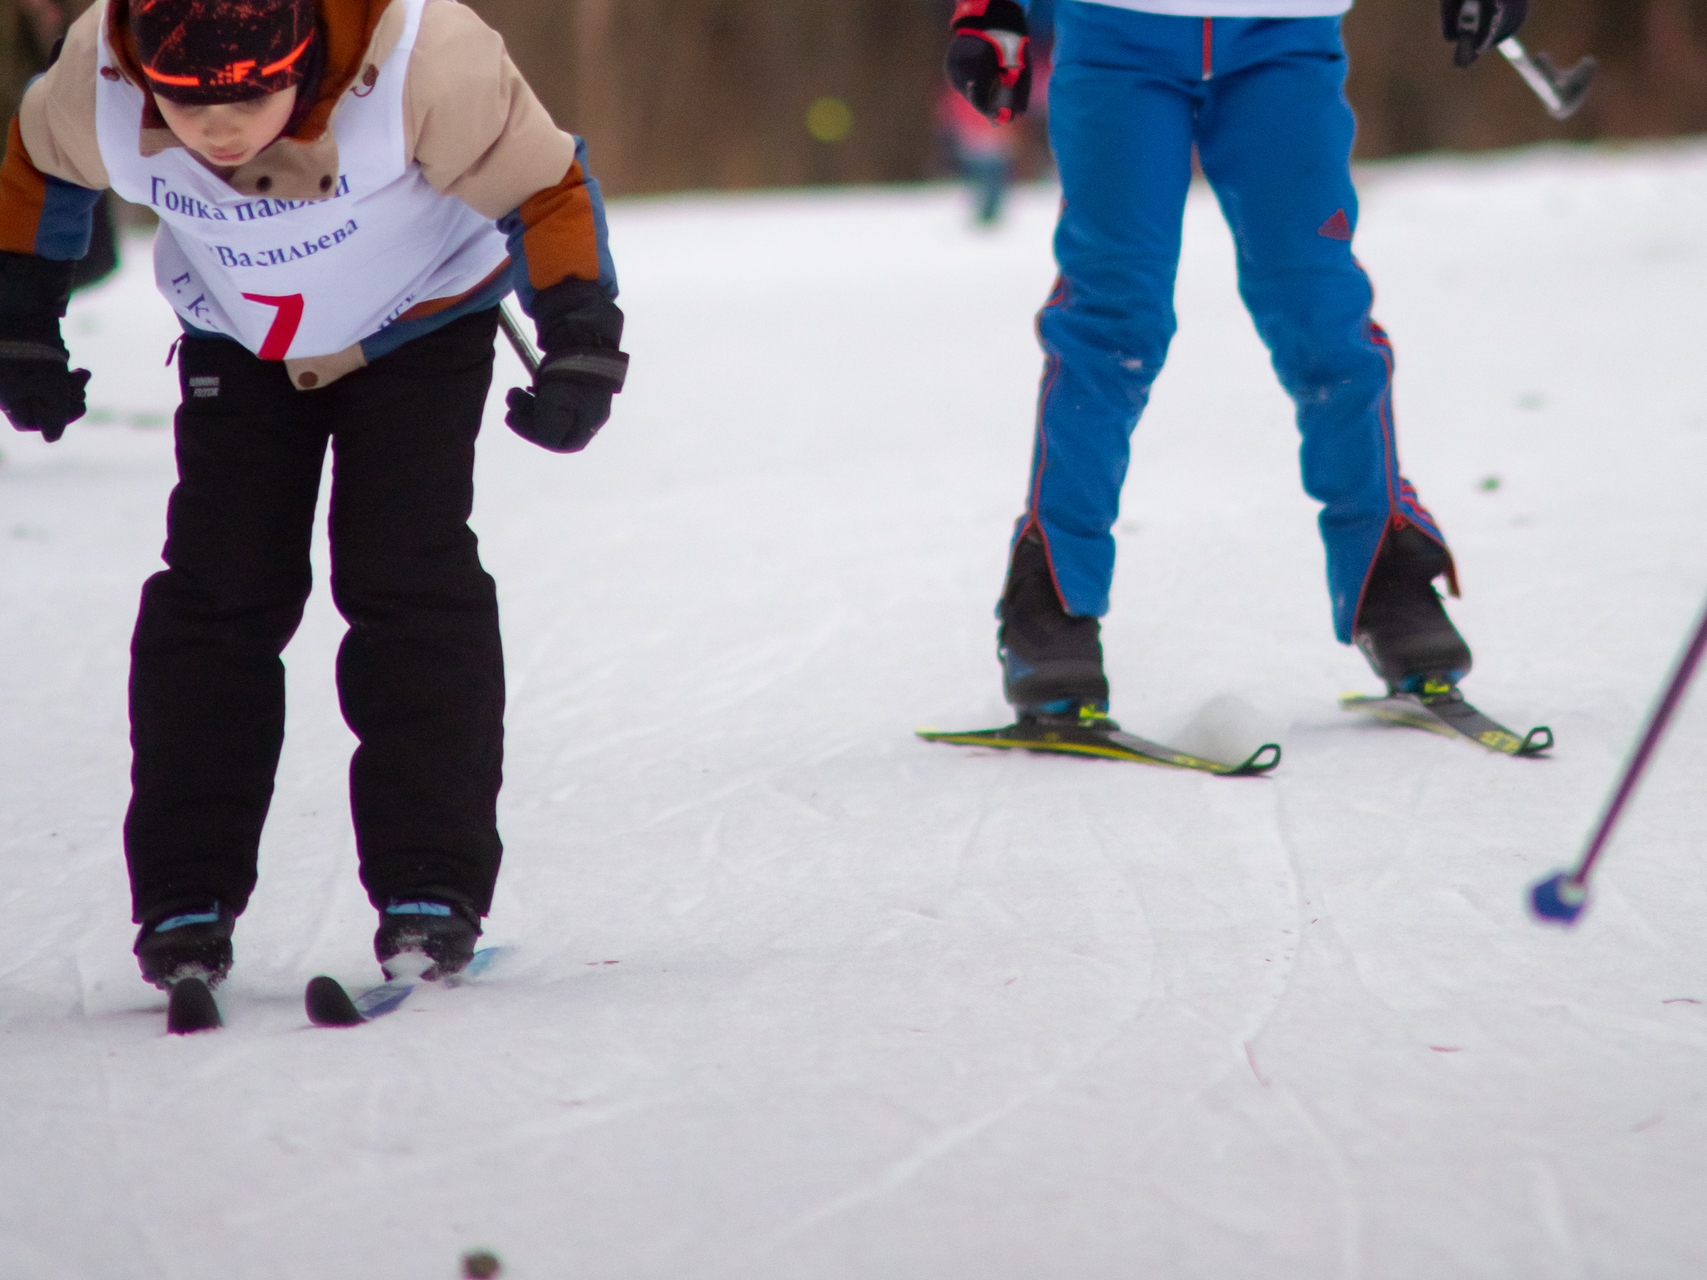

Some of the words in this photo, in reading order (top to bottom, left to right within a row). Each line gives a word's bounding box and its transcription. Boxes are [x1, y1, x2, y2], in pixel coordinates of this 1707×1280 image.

[151, 176, 229, 221] Гонка
[215, 218, 359, 268] Васильева
[240, 292, 304, 361] 7
